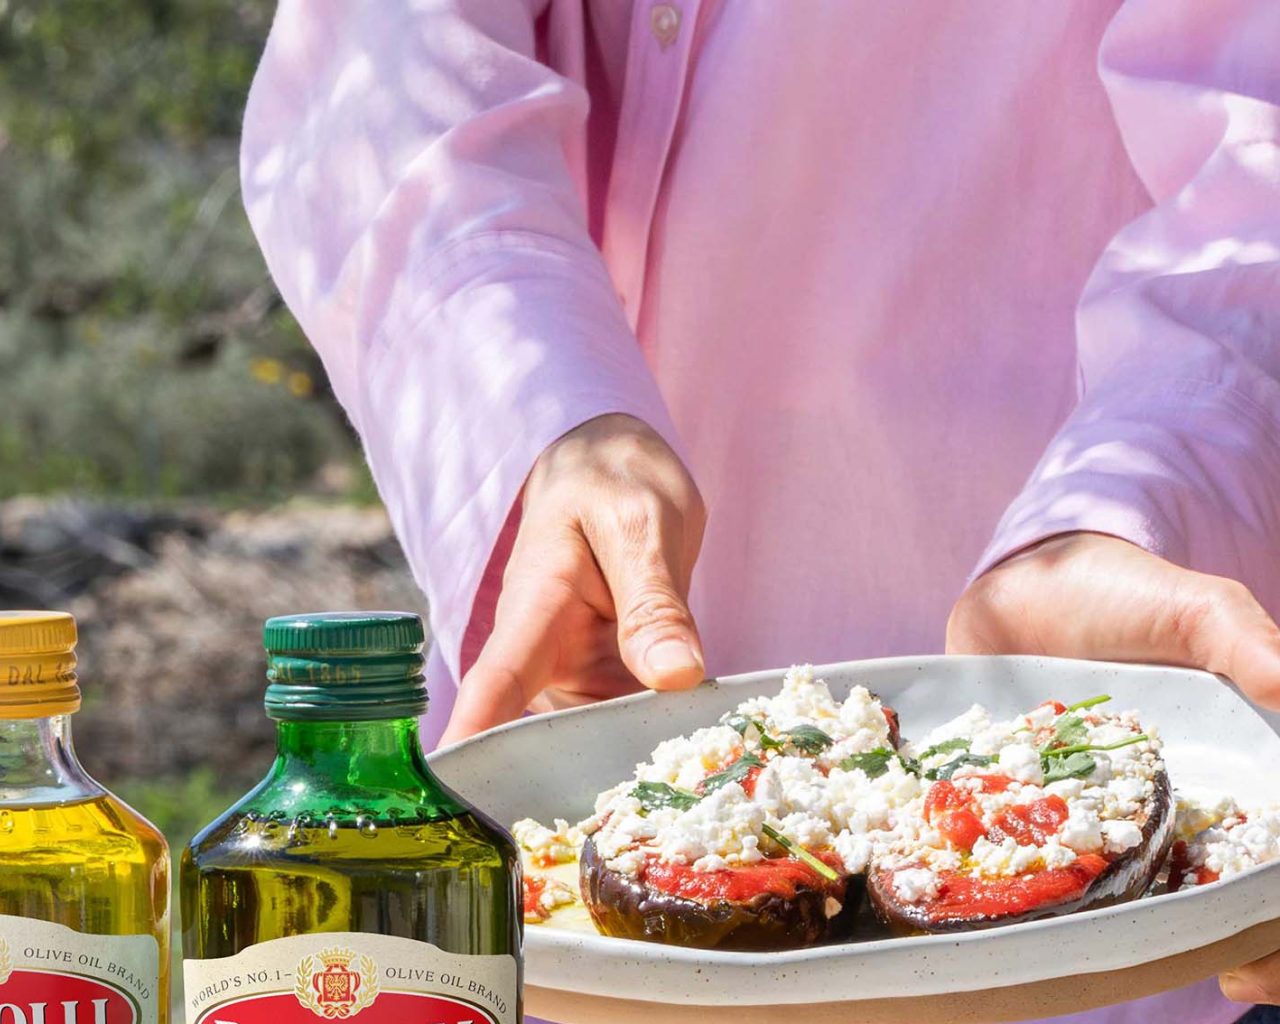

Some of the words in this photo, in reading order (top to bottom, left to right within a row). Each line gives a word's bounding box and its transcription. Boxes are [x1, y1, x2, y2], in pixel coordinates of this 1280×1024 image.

[8, 664, 46, 686] DAL
[306, 662, 361, 683] 1865
[23, 947, 72, 963] OLIVE
[78, 954, 103, 969] OIL
[107, 962, 150, 1000] BRAND
[191, 976, 241, 1008] WORLD'S
[385, 967, 435, 982] OLIVE
[440, 973, 464, 989] OIL
[467, 980, 507, 1014] BRAND
